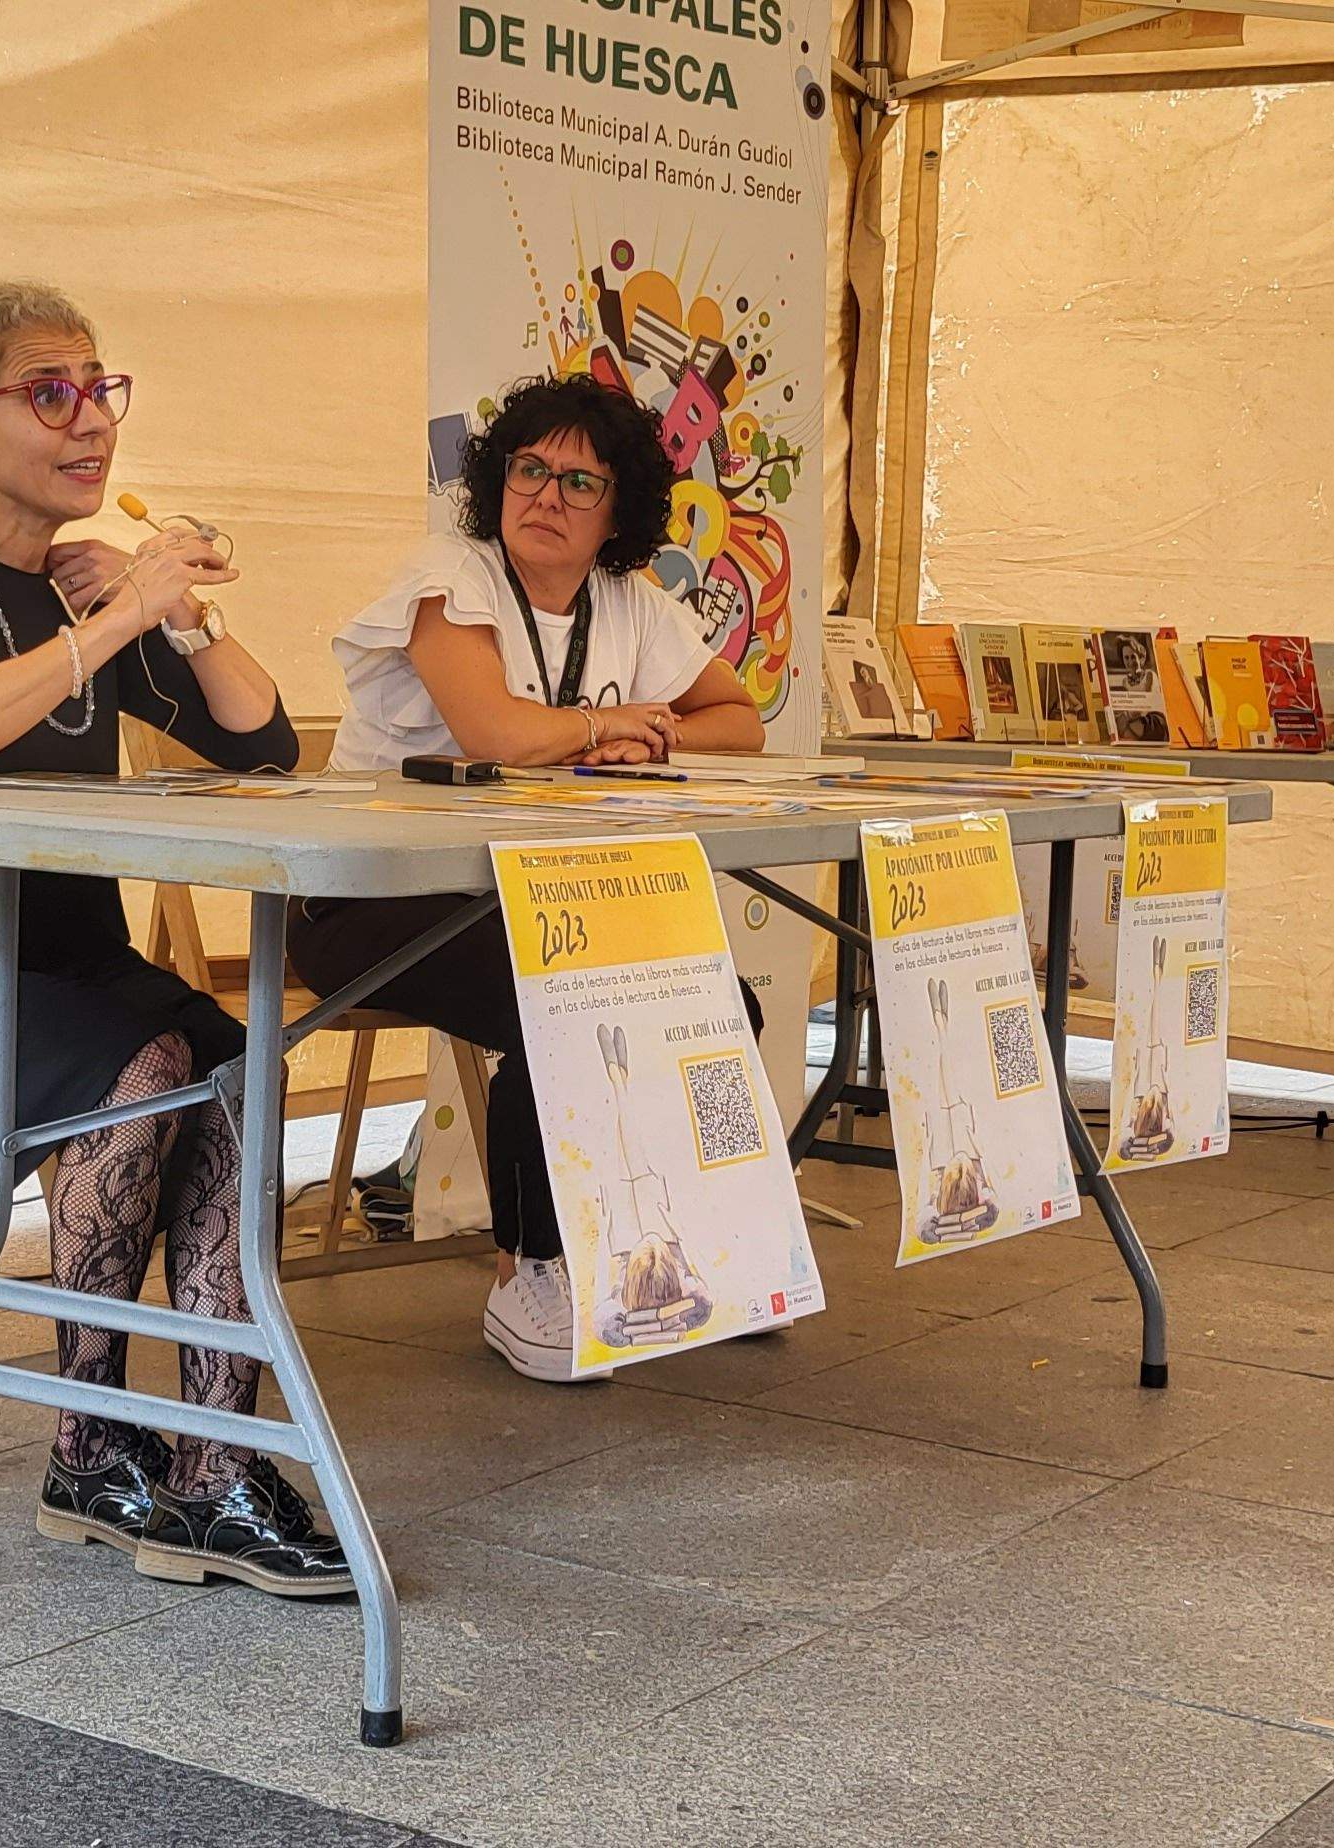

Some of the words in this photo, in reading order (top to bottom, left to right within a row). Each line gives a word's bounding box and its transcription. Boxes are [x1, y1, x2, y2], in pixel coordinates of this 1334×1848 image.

[596, 0, 782, 46] ALES
[458, 5, 526, 67] DE
[546, 24, 738, 110] HUESCA
[457, 86, 554, 125] Biblioteca
[561, 105, 648, 145] Municipal
[654, 124, 672, 148] A.
[678, 129, 730, 158] Durán
[738, 140, 792, 170] Gudiol
[457, 125, 554, 162] Biblioteca
[561, 143, 648, 181] Municipal
[656, 160, 715, 191] Ramón
[721, 173, 736, 194] J.
[744, 175, 801, 205] Sender
[886, 853, 934, 879] APASIÓNATE
[936, 851, 954, 871] POR
[954, 850, 966, 869] LA
[966, 845, 998, 867] LECTURA
[1137, 851, 1162, 891] 2023
[527, 876, 597, 904] APASIÓNATE
[597, 878, 624, 899] POR
[625, 876, 642, 896] LA
[642, 871, 690, 894] LECTURA
[889, 881, 926, 930] 2023
[535, 909, 588, 966] 2023
[544, 979, 569, 994] Guía
[571, 976, 584, 990] de
[586, 974, 618, 989] lectura
[620, 970, 631, 984] de
[632, 968, 645, 982] los
[645, 966, 671, 981] libros
[672, 964, 690, 977] más
[548, 1004, 562, 1015] en
[564, 998, 578, 1013] los
[580, 995, 610, 1010] clubes
[612, 992, 624, 1006] de
[626, 988, 657, 1004] lectura
[658, 985, 671, 999] de
[672, 983, 701, 997] huesca
